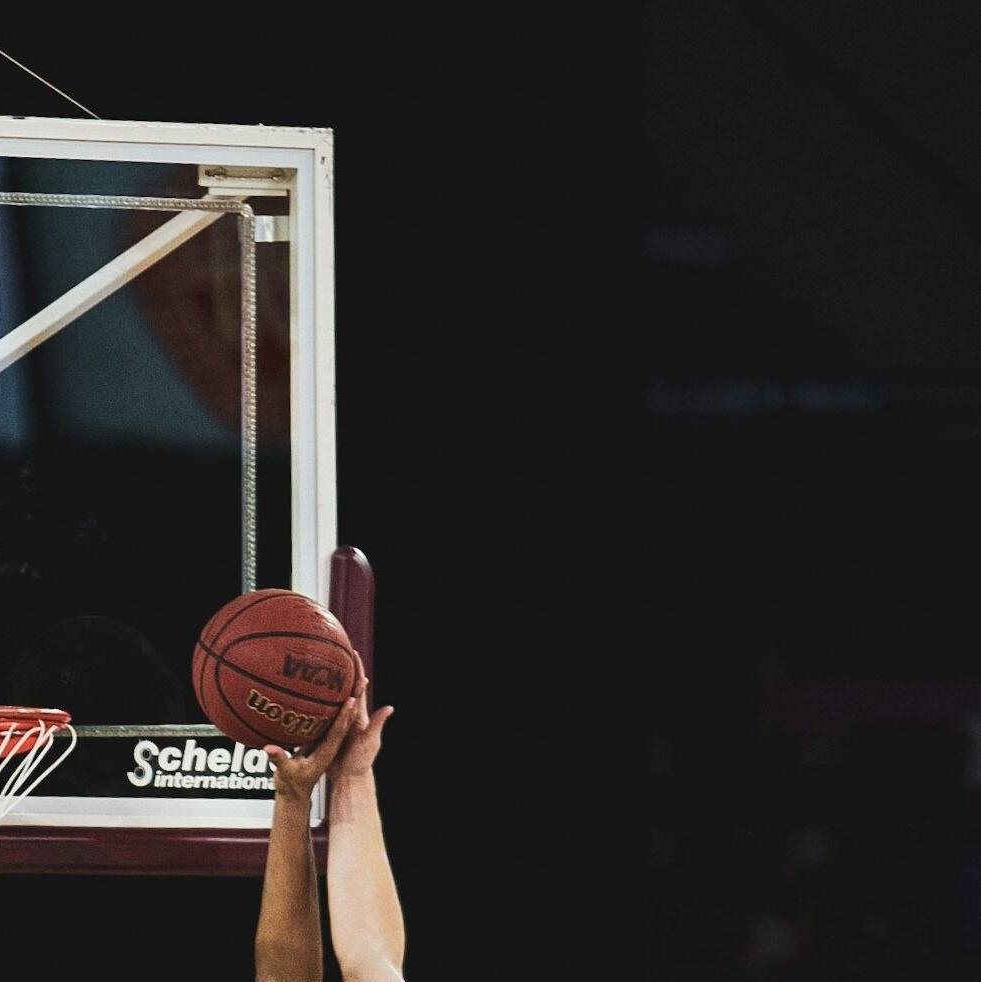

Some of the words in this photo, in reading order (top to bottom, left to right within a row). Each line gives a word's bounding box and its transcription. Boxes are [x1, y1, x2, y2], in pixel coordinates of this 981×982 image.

[247, 689, 331, 736] ilson
[126, 739, 291, 787] Scheld
[154, 770, 276, 790] internationa
